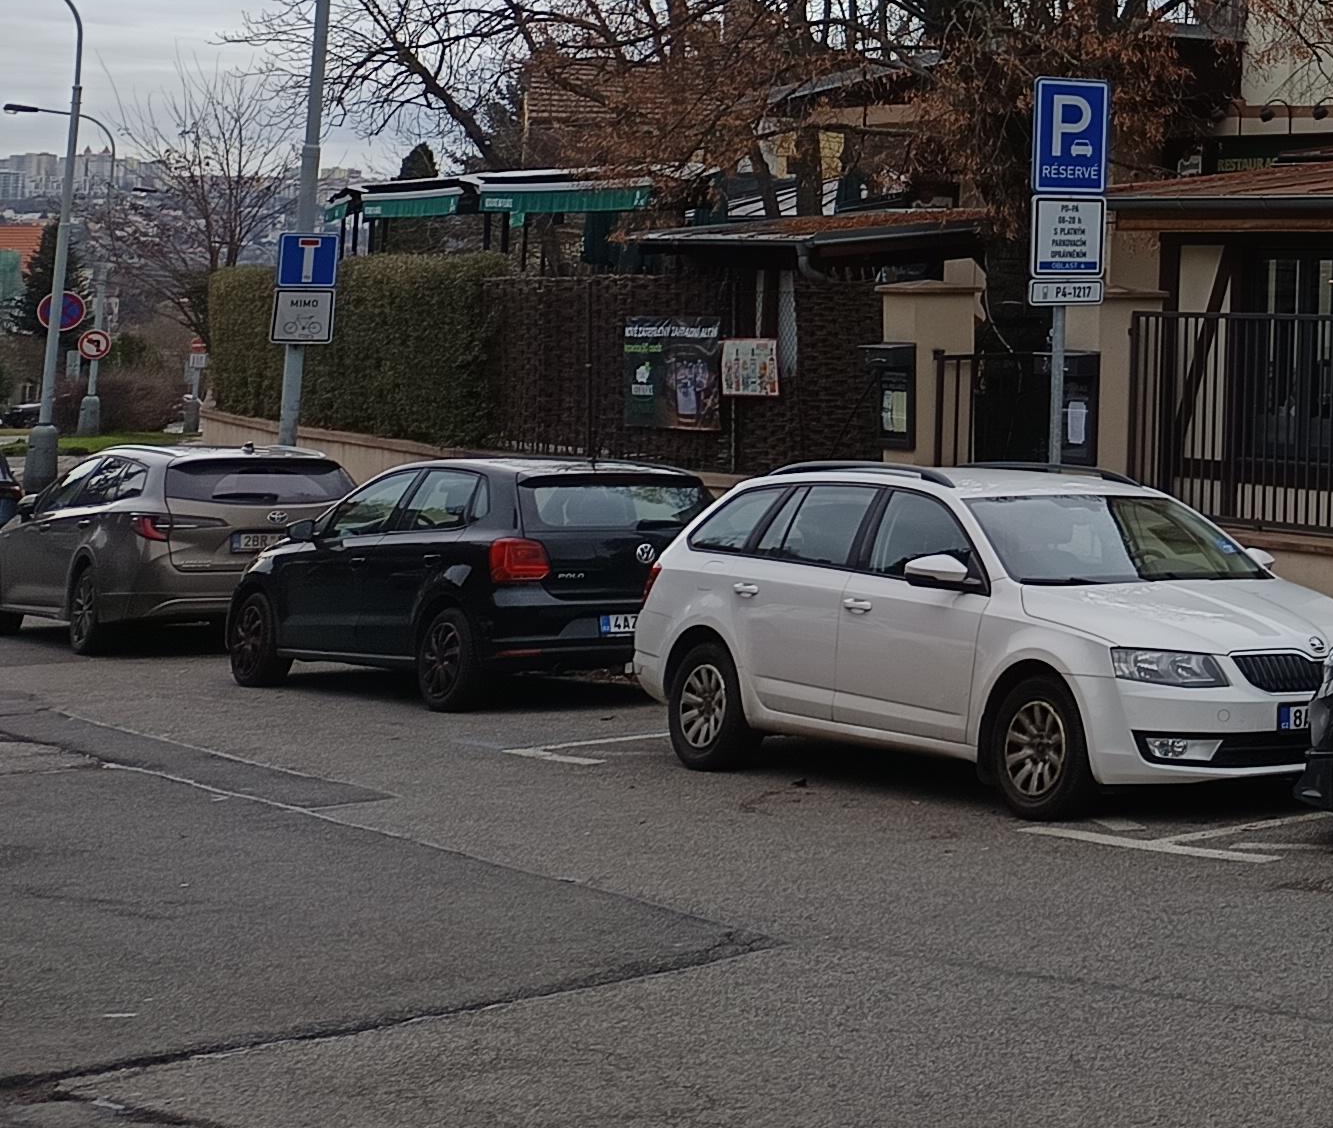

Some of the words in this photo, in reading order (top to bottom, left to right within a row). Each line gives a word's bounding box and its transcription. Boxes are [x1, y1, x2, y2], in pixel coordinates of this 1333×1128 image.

[1042, 163, 1099, 180] RÉSERVÉ
[1055, 286, 1092, 298] P4-1217
[290, 299, 319, 308] MIMO
